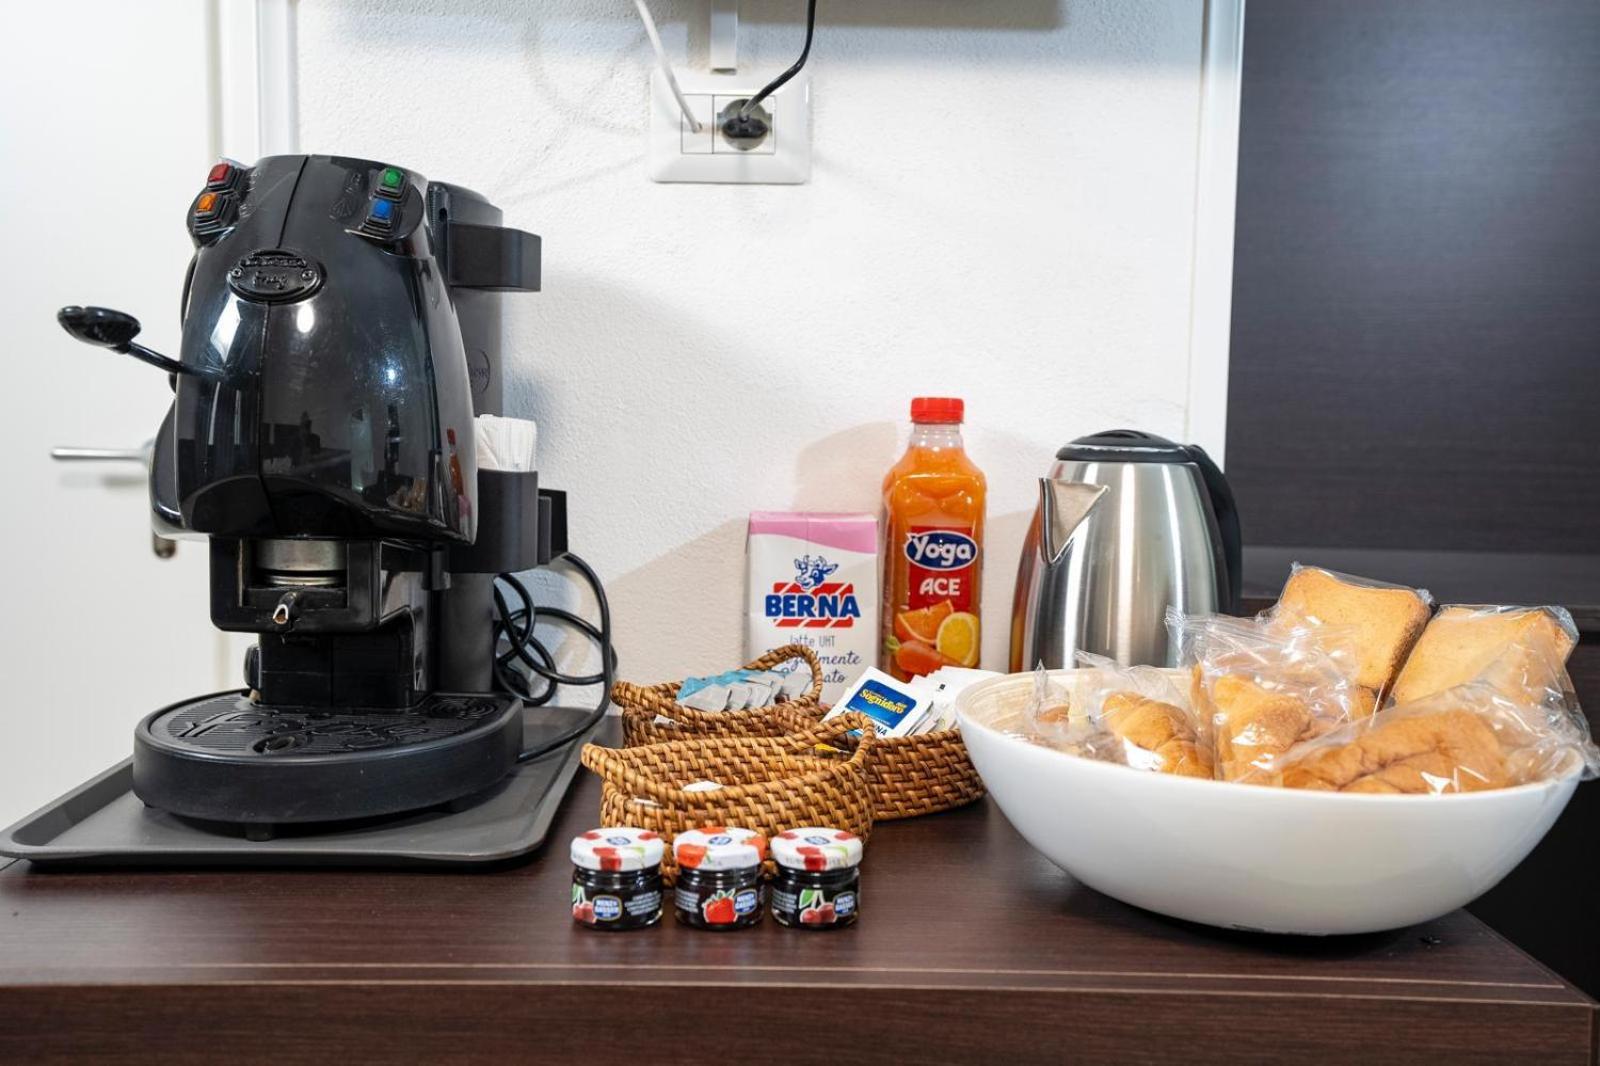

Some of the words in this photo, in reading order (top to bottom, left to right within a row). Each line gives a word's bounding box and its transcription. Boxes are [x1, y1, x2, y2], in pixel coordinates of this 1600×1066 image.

[912, 534, 972, 567] Yoga
[919, 577, 961, 596] ACE
[765, 594, 861, 618] BERNA
[819, 635, 836, 648] UHT
